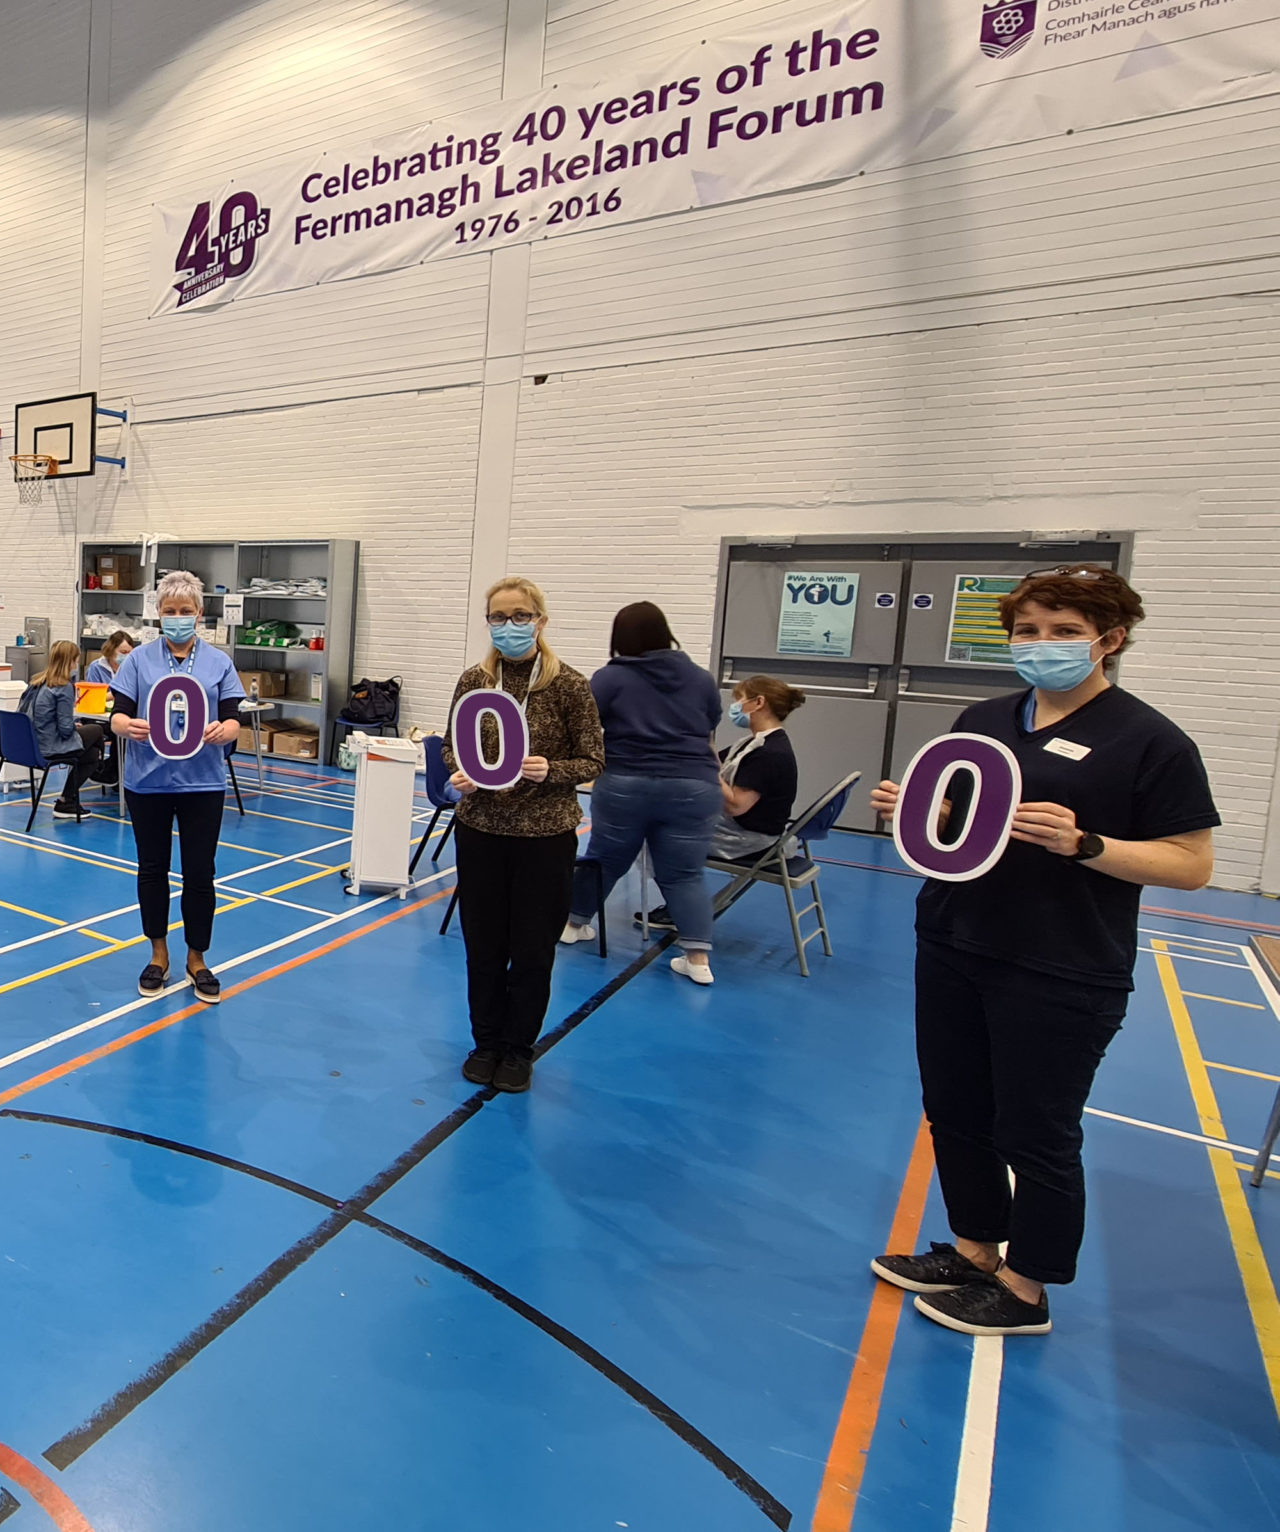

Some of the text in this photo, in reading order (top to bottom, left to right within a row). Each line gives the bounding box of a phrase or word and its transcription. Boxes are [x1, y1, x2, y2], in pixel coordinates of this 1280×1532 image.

[1043, 27, 1089, 46] Fhear
[1090, 11, 1155, 35] Manach
[1157, 2, 1196, 19] agus
[1045, 3, 1125, 31] Comhairle
[301, 28, 880, 204] Celebrating 40 years of the
[294, 81, 884, 245] Fermanagh Lakeland Forum
[175, 191, 259, 279] 40
[220, 213, 267, 254] YEARS
[454, 209, 520, 244] 1976
[546, 187, 622, 226] 2016
[182, 274, 225, 303] CELEBRATION
[183, 262, 225, 290] ANNIVERSARY
[786, 582, 855, 606] YOU
[809, 575, 824, 583] Are
[826, 575, 847, 583] With
[148, 676, 206, 757] 0
[455, 692, 525, 786] 0
[899, 737, 1014, 875] 0
